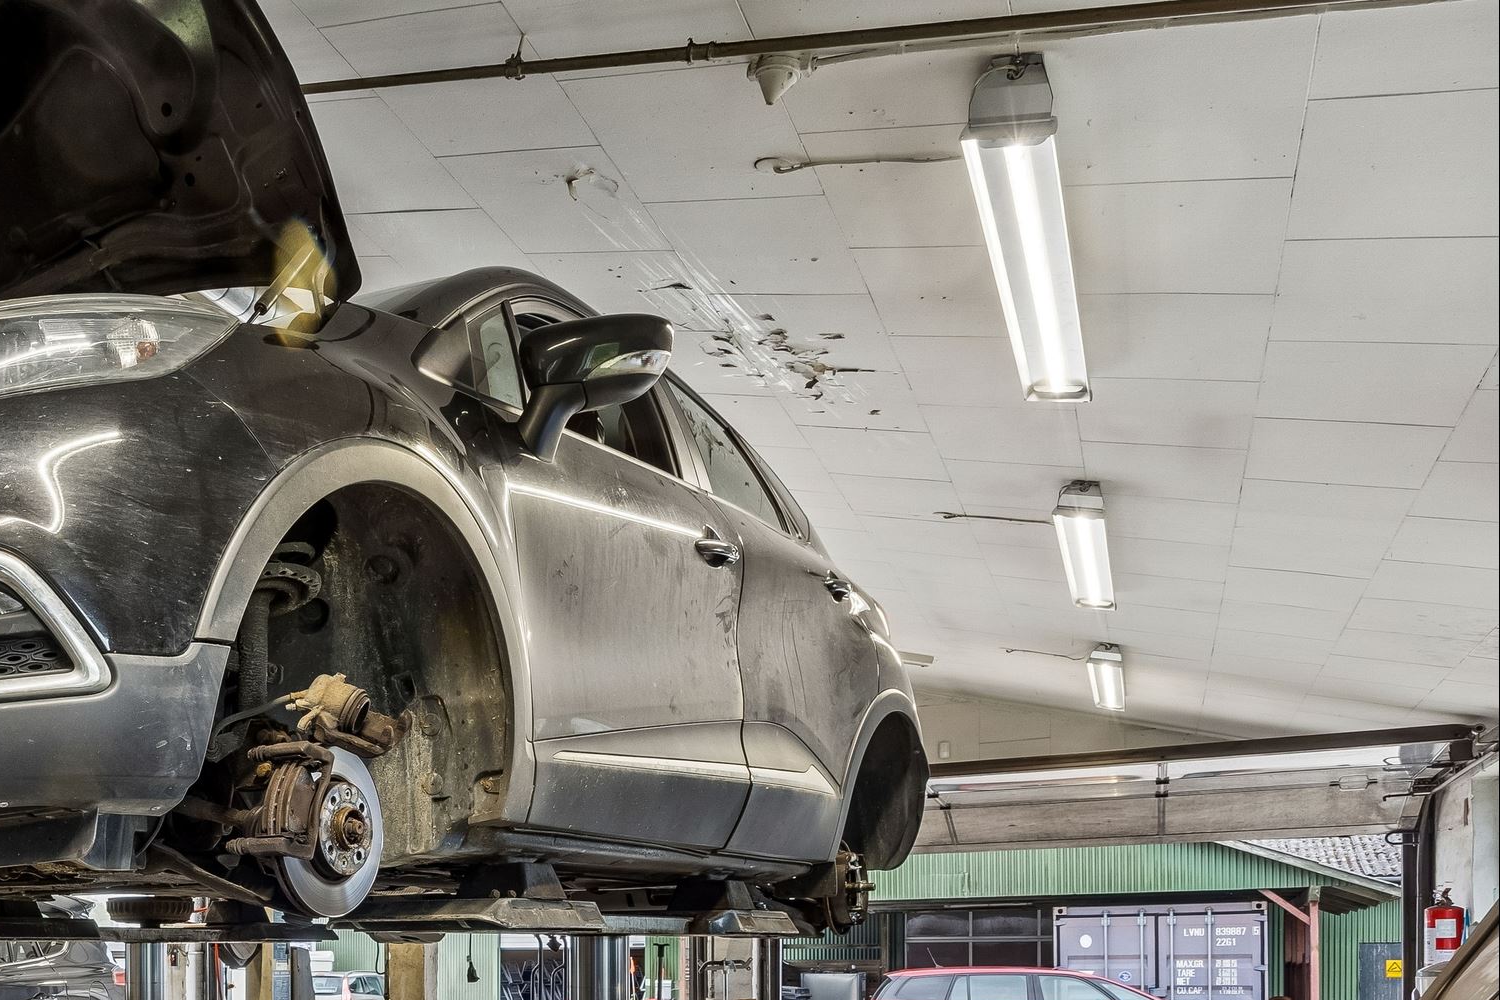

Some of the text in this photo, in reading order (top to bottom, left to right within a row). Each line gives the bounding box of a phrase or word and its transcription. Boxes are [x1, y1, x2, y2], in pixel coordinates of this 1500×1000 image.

[1183, 928, 1205, 936] LVNU
[1215, 927, 1246, 936] 839887
[1216, 938, 1236, 946] 22G1
[1177, 969, 1195, 977] TARE
[1177, 977, 1190, 985] NET
